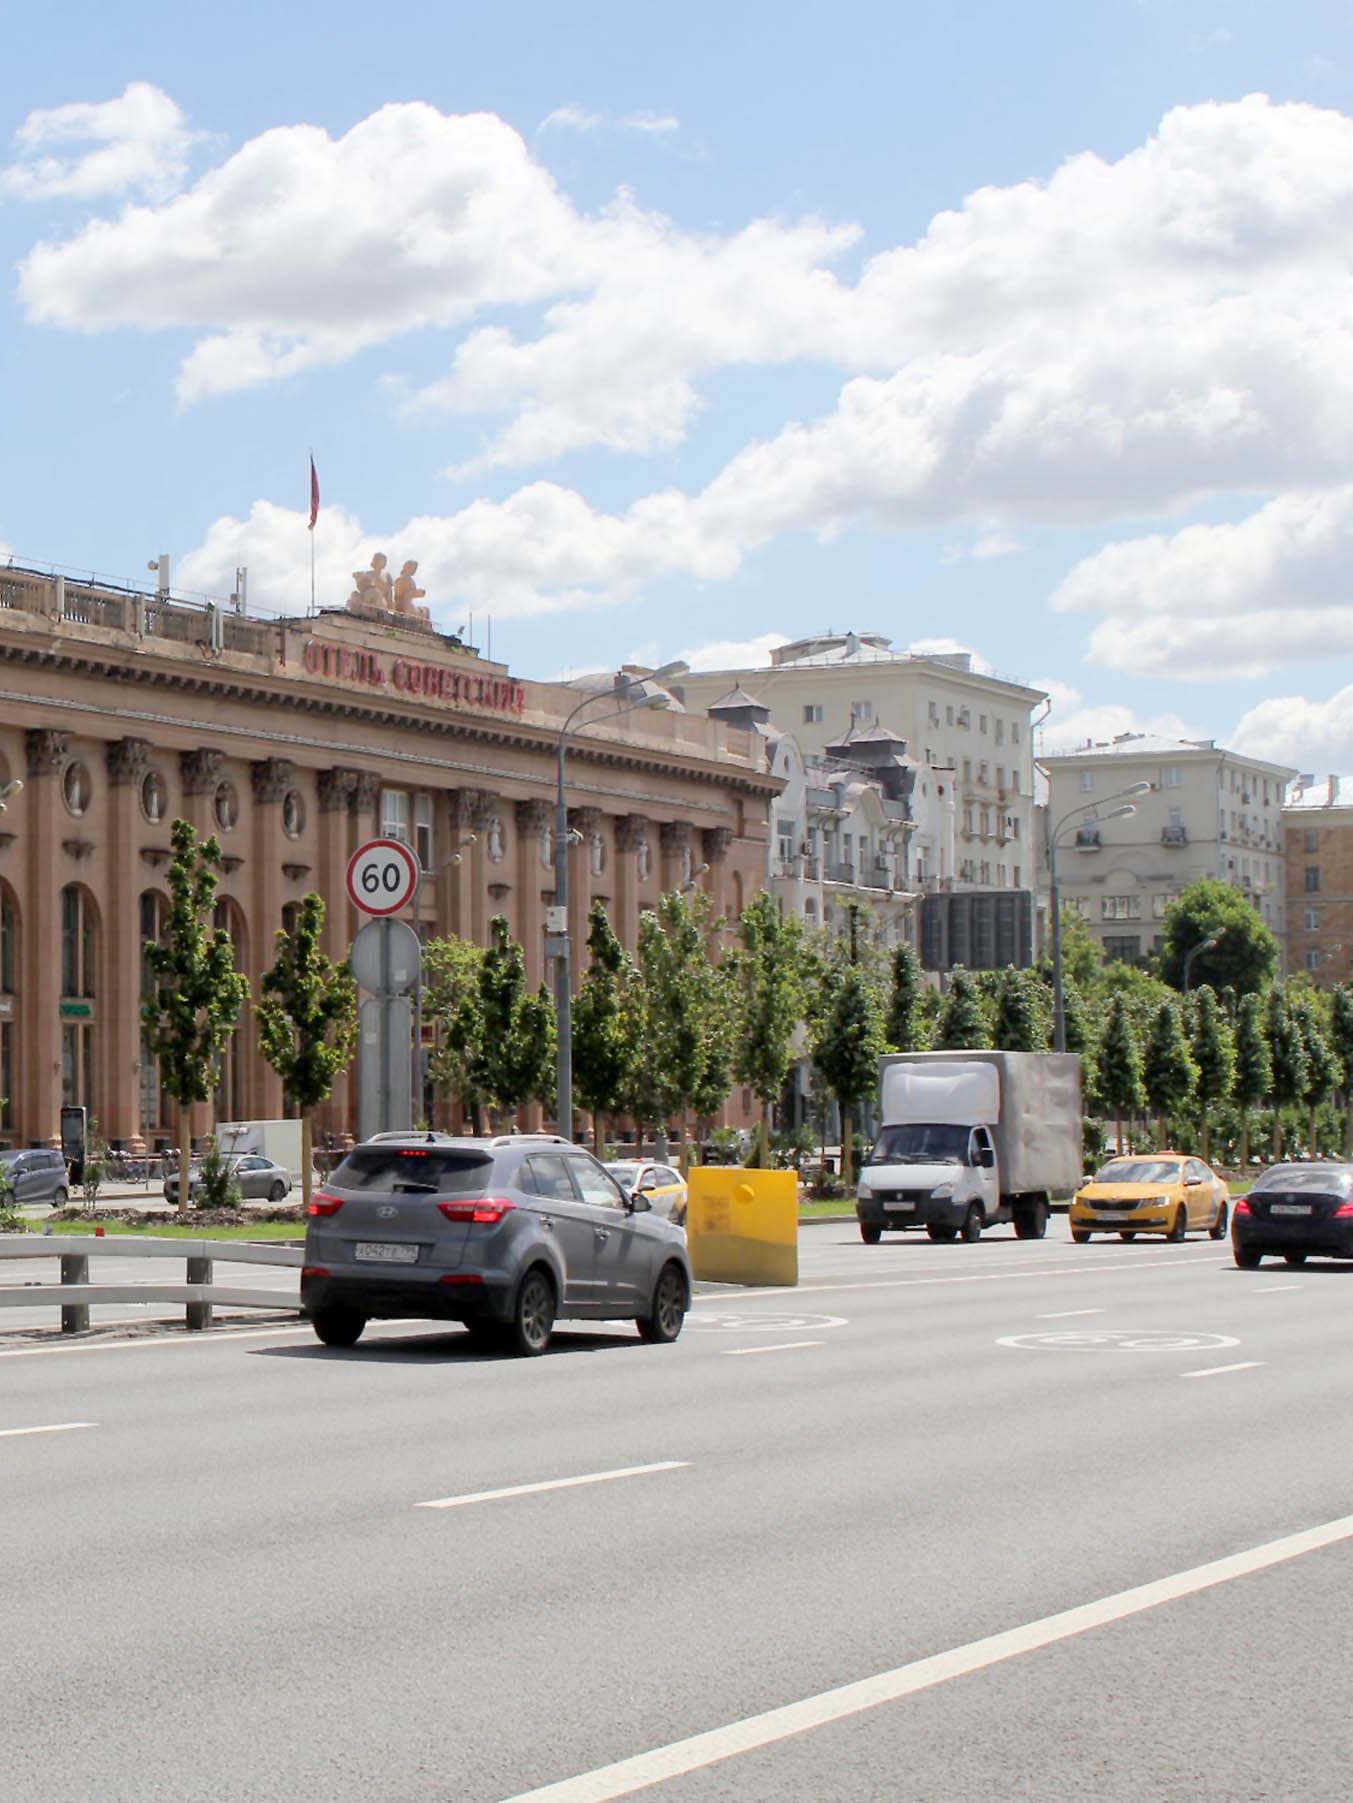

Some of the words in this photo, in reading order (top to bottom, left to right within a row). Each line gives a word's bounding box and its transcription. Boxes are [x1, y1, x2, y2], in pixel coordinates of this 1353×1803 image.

[304, 640, 385, 686] ОТЕЛЬ
[393, 657, 526, 714] СОВЕТСКИЙ
[362, 863, 400, 893] 60
